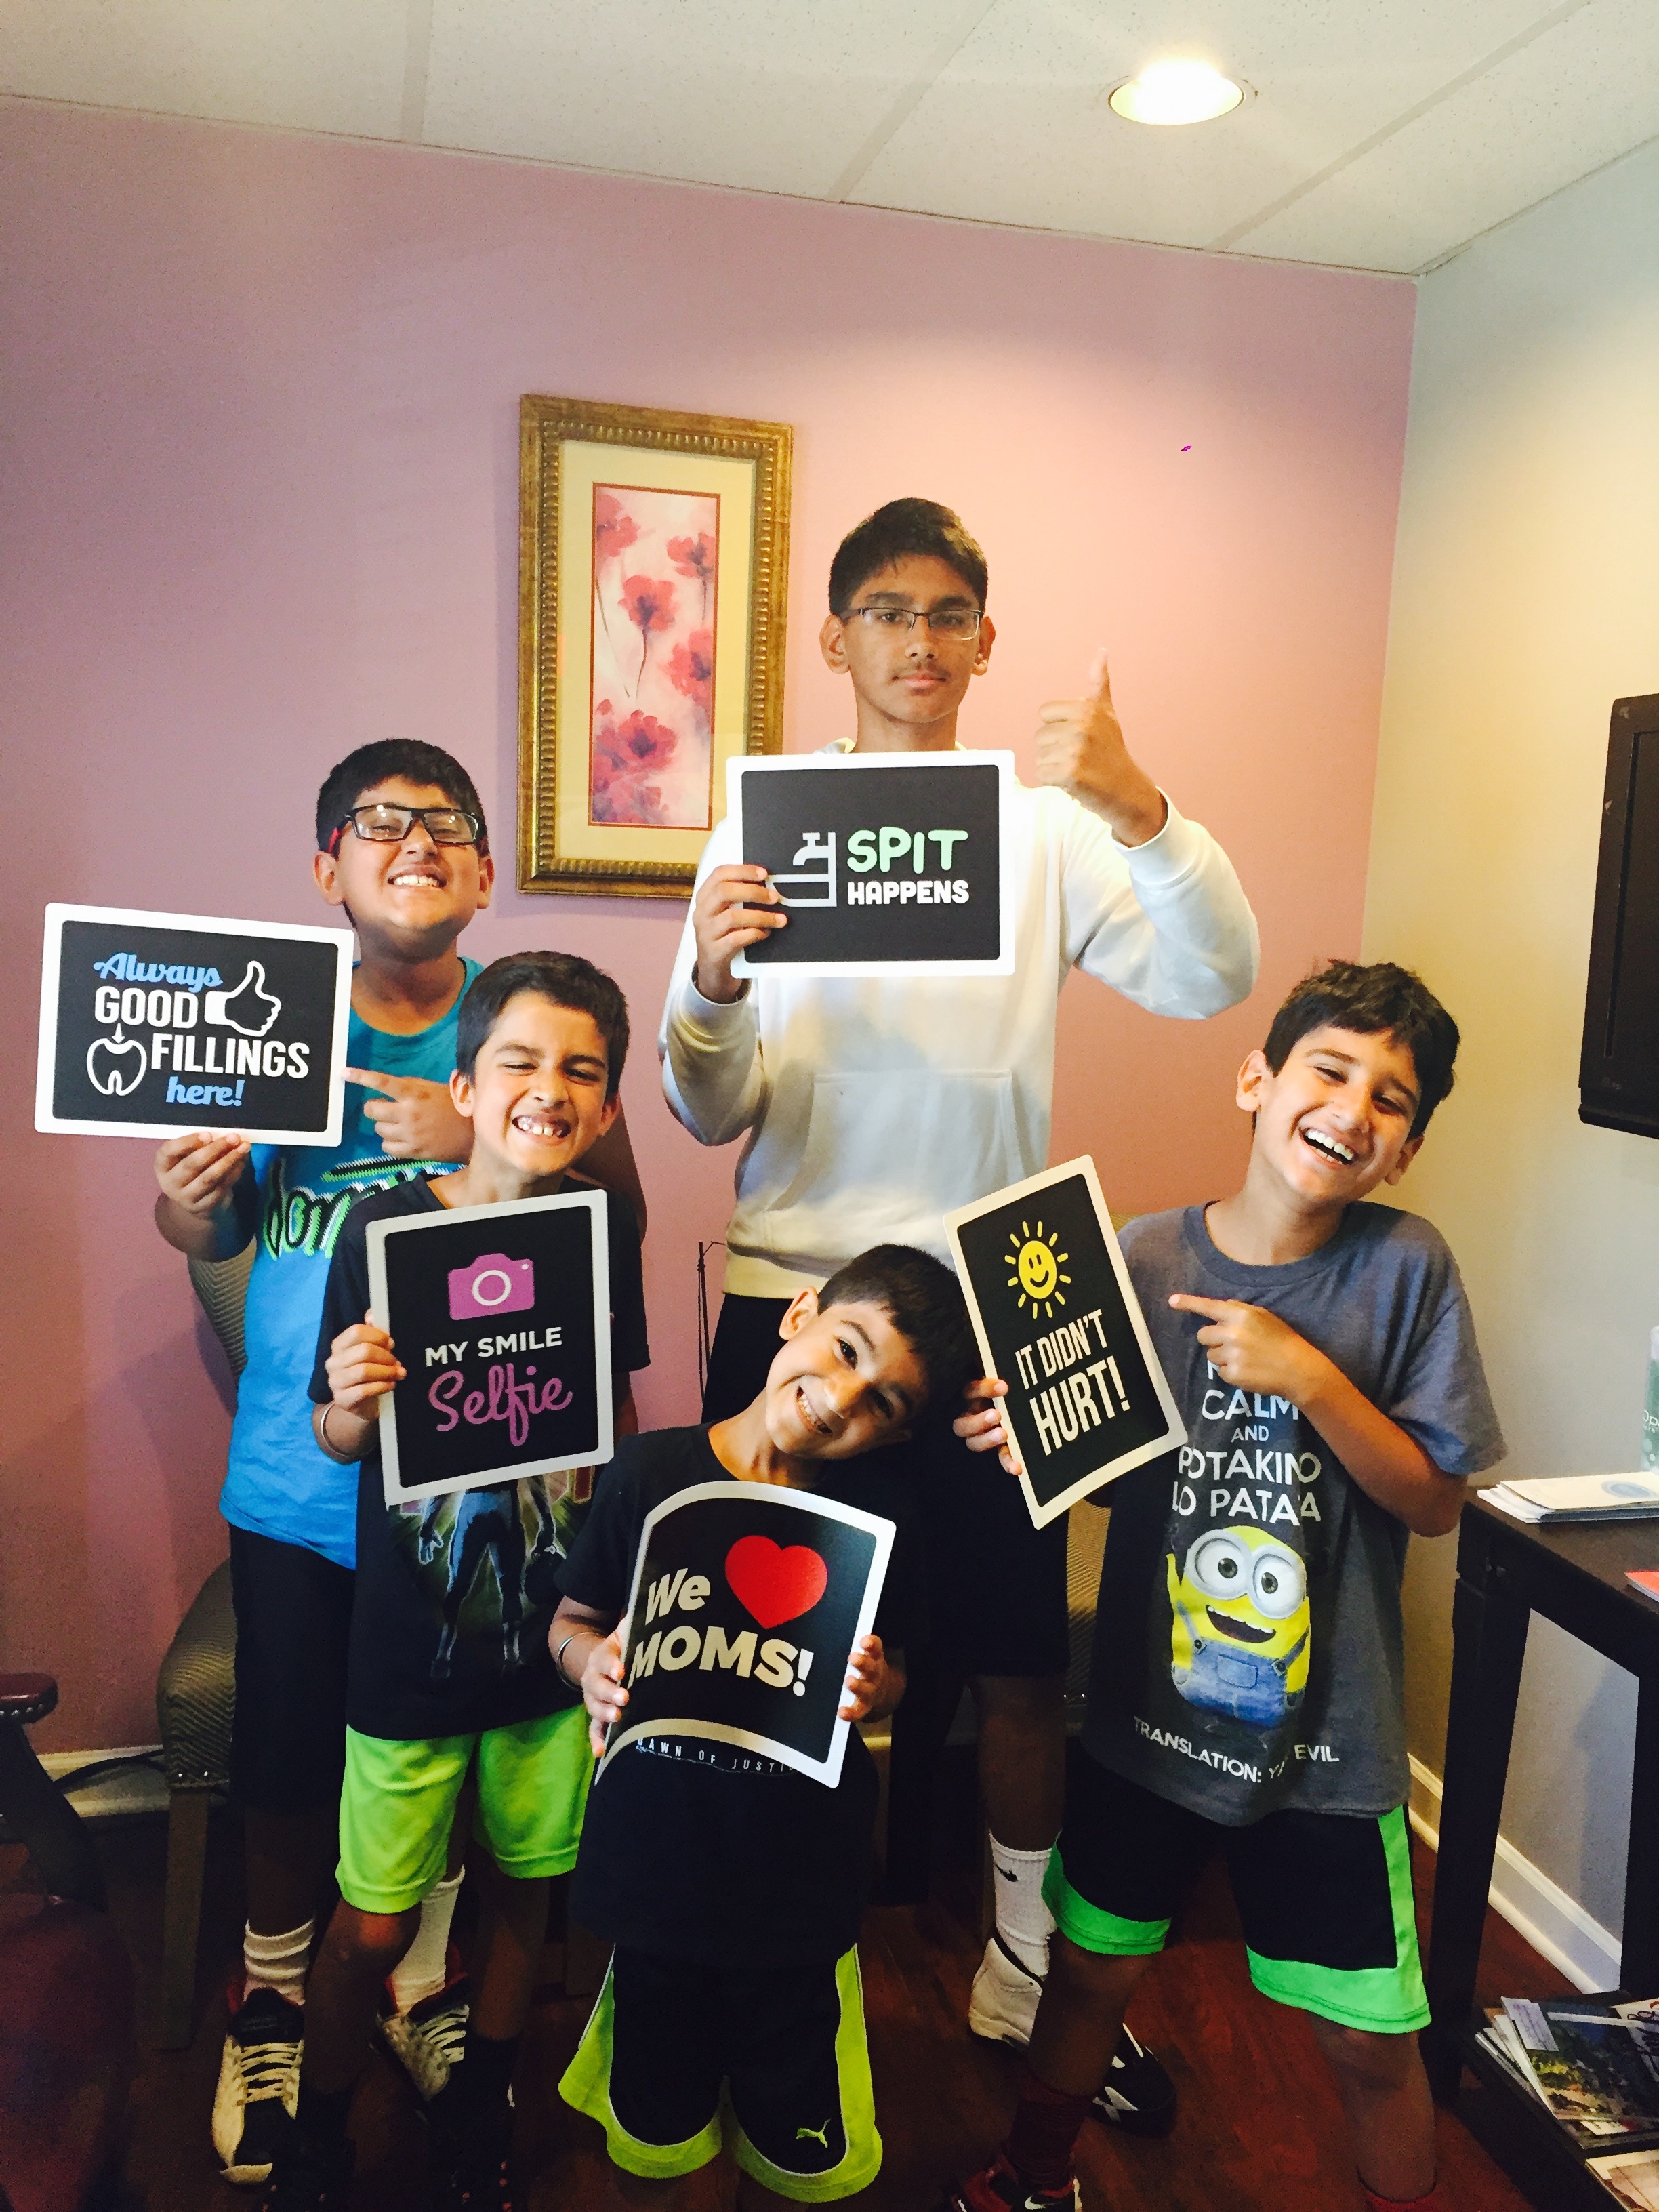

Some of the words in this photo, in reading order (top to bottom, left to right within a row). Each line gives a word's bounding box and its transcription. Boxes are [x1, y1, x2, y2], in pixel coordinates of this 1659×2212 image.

[847, 826, 968, 874] SPIT
[847, 880, 969, 905] HAPPENS
[94, 952, 223, 992] Always
[94, 986, 198, 1029] GOOD
[151, 1033, 310, 1079] FILLINGS
[165, 1076, 245, 1107] here!
[425, 1341, 468, 1367] MY
[477, 1326, 562, 1357] SMILE
[1015, 1345, 1039, 1390] IT
[1036, 1309, 1109, 1378] DIDN'T
[428, 1363, 573, 1446] Selfie
[1029, 1355, 1130, 1456] HURT!
[1202, 1389, 1299, 1420] CALM
[1231, 1425, 1269, 1443] AND
[1210, 1488, 1322, 1526] PATAA
[644, 1568, 711, 1626] We
[628, 1624, 815, 1697] MOMS!
[637, 1738, 682, 1757] DAWN
[699, 1750, 716, 1763] OF
[732, 1759, 793, 1773] JUSTI
[1134, 1716, 1262, 1783] TRANSLATION:
[1294, 1744, 1339, 1762] EVIL
